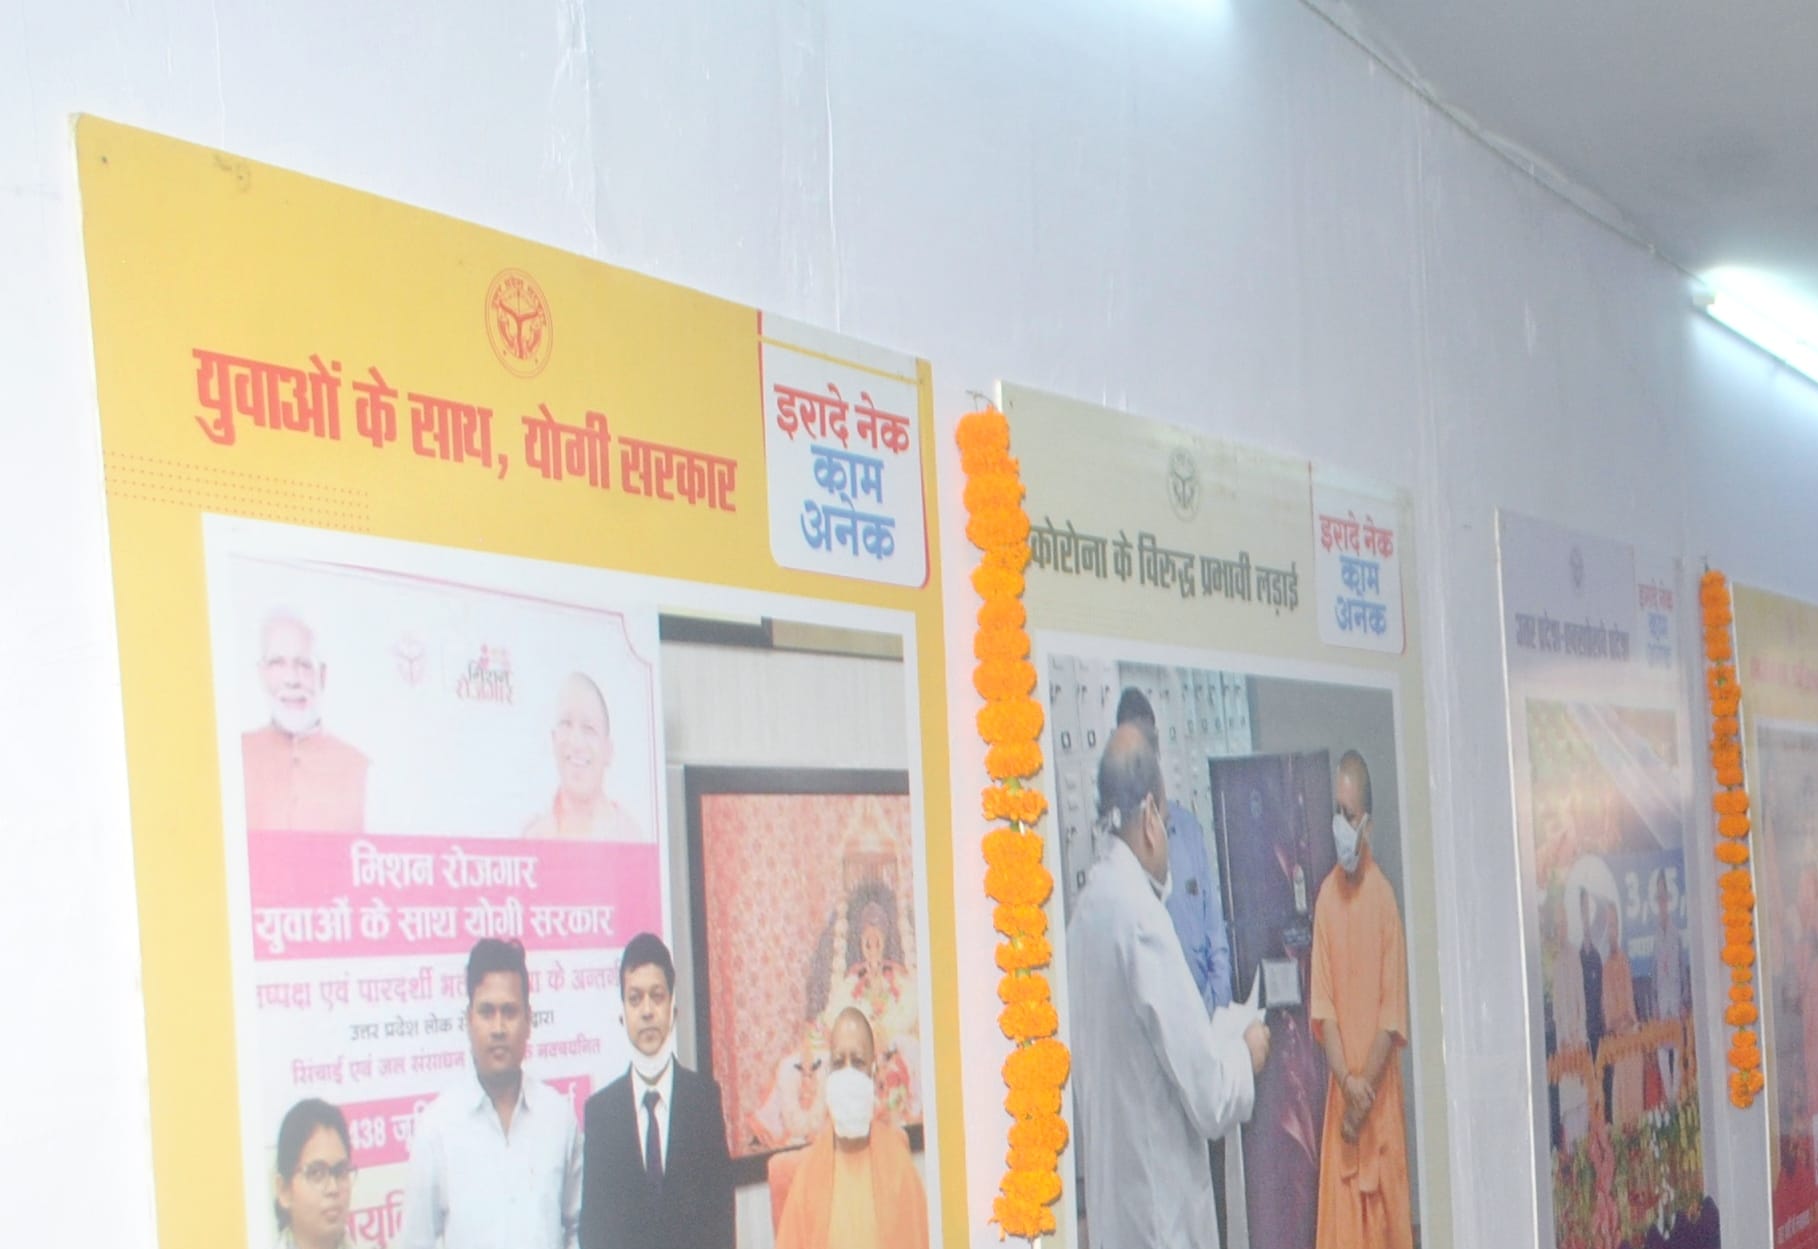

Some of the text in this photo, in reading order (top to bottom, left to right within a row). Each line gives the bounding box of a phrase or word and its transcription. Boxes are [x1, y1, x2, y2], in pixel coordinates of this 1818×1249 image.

[192, 348, 738, 513] युवाओं के साथ, योगी सरकार
[773, 382, 910, 454] इरादे नेक
[810, 443, 884, 504] काम
[800, 492, 896, 560] अनेक
[1319, 509, 1394, 559] इरादे नेक
[1030, 515, 1299, 617] कोरोना के विरुद्ध प्रभावी लड़ाई
[1339, 554, 1380, 596] काम
[1334, 588, 1387, 636] अनेक
[351, 839, 538, 890] मिशन रोजगार
[256, 896, 615, 954] युवाओं के साथ योगी सरकार
